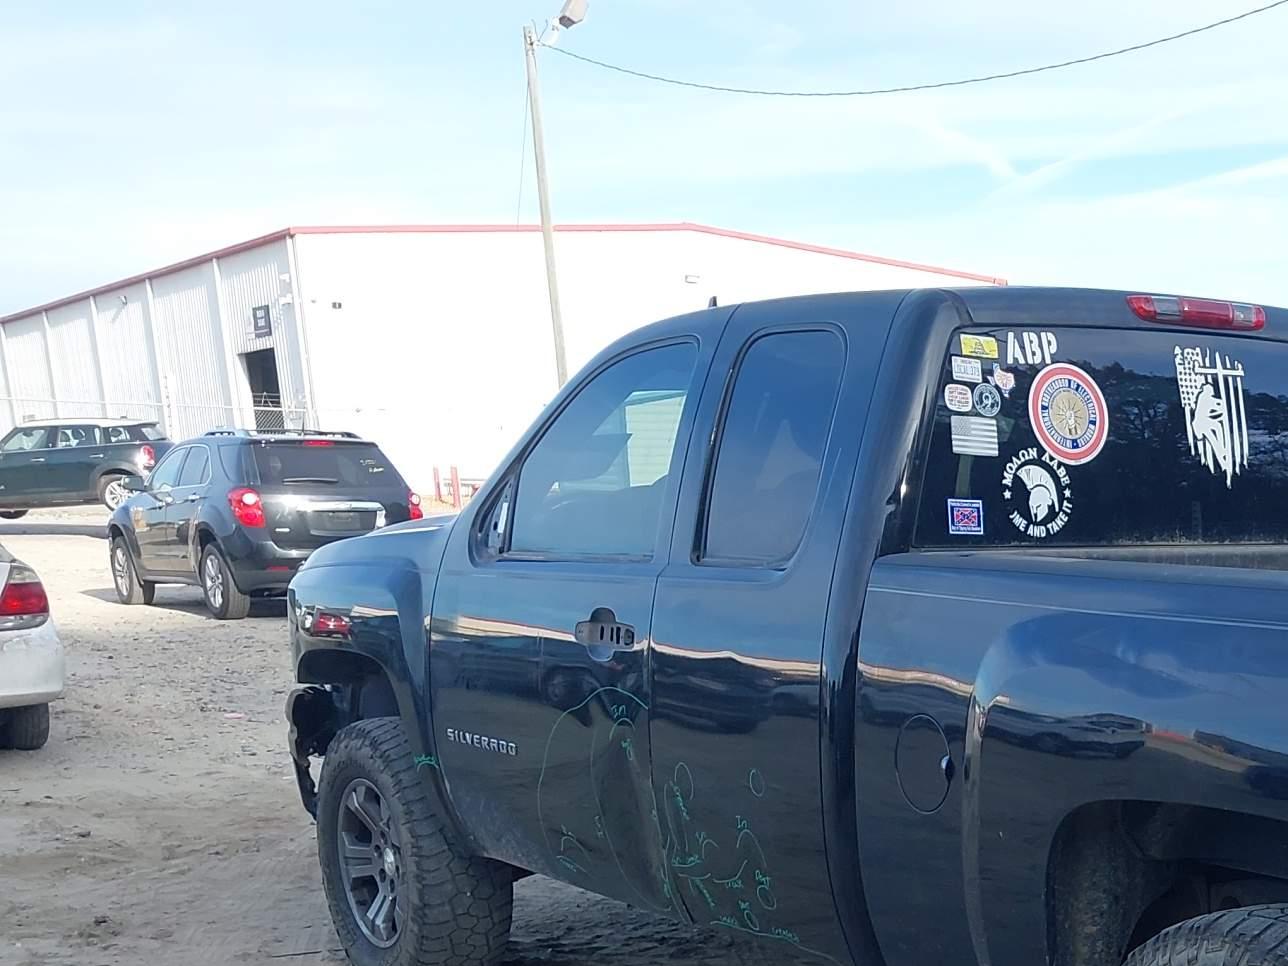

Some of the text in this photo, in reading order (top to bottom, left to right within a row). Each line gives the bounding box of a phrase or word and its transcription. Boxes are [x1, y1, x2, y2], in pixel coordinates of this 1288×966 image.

[1007, 331, 1057, 364] ABP
[1027, 523, 1046, 537] AND
[1047, 511, 1069, 535] TAKE
[1062, 500, 1073, 514] IT
[447, 728, 517, 756] SILVERADO
